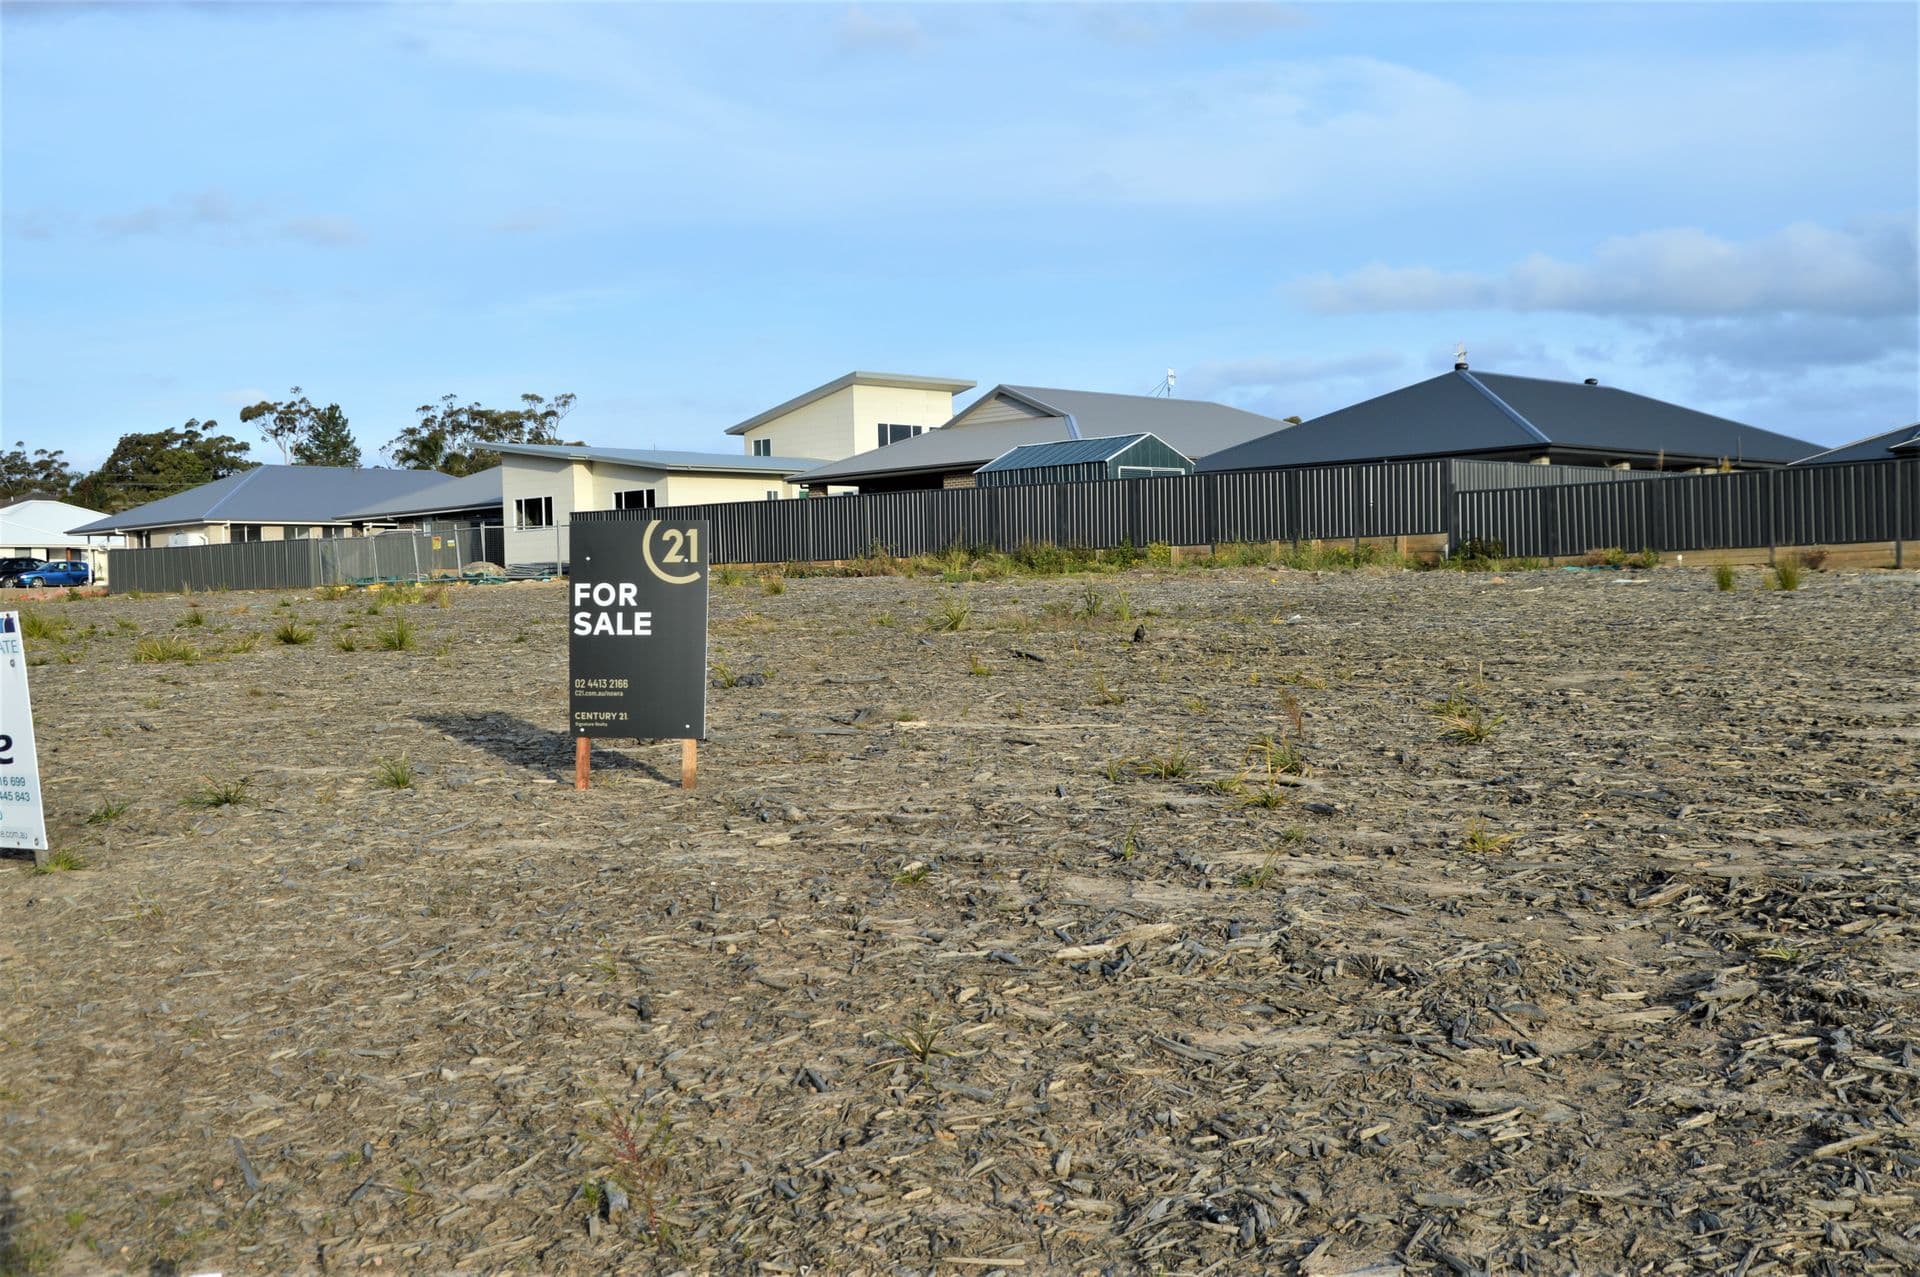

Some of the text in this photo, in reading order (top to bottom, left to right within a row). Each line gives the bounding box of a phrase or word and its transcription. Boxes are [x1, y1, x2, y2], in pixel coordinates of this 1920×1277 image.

[574, 583, 638, 607] FOR
[573, 611, 652, 636] SALE
[575, 679, 629, 689] 02 4413 2166
[575, 712, 628, 721] CENTURY 21
